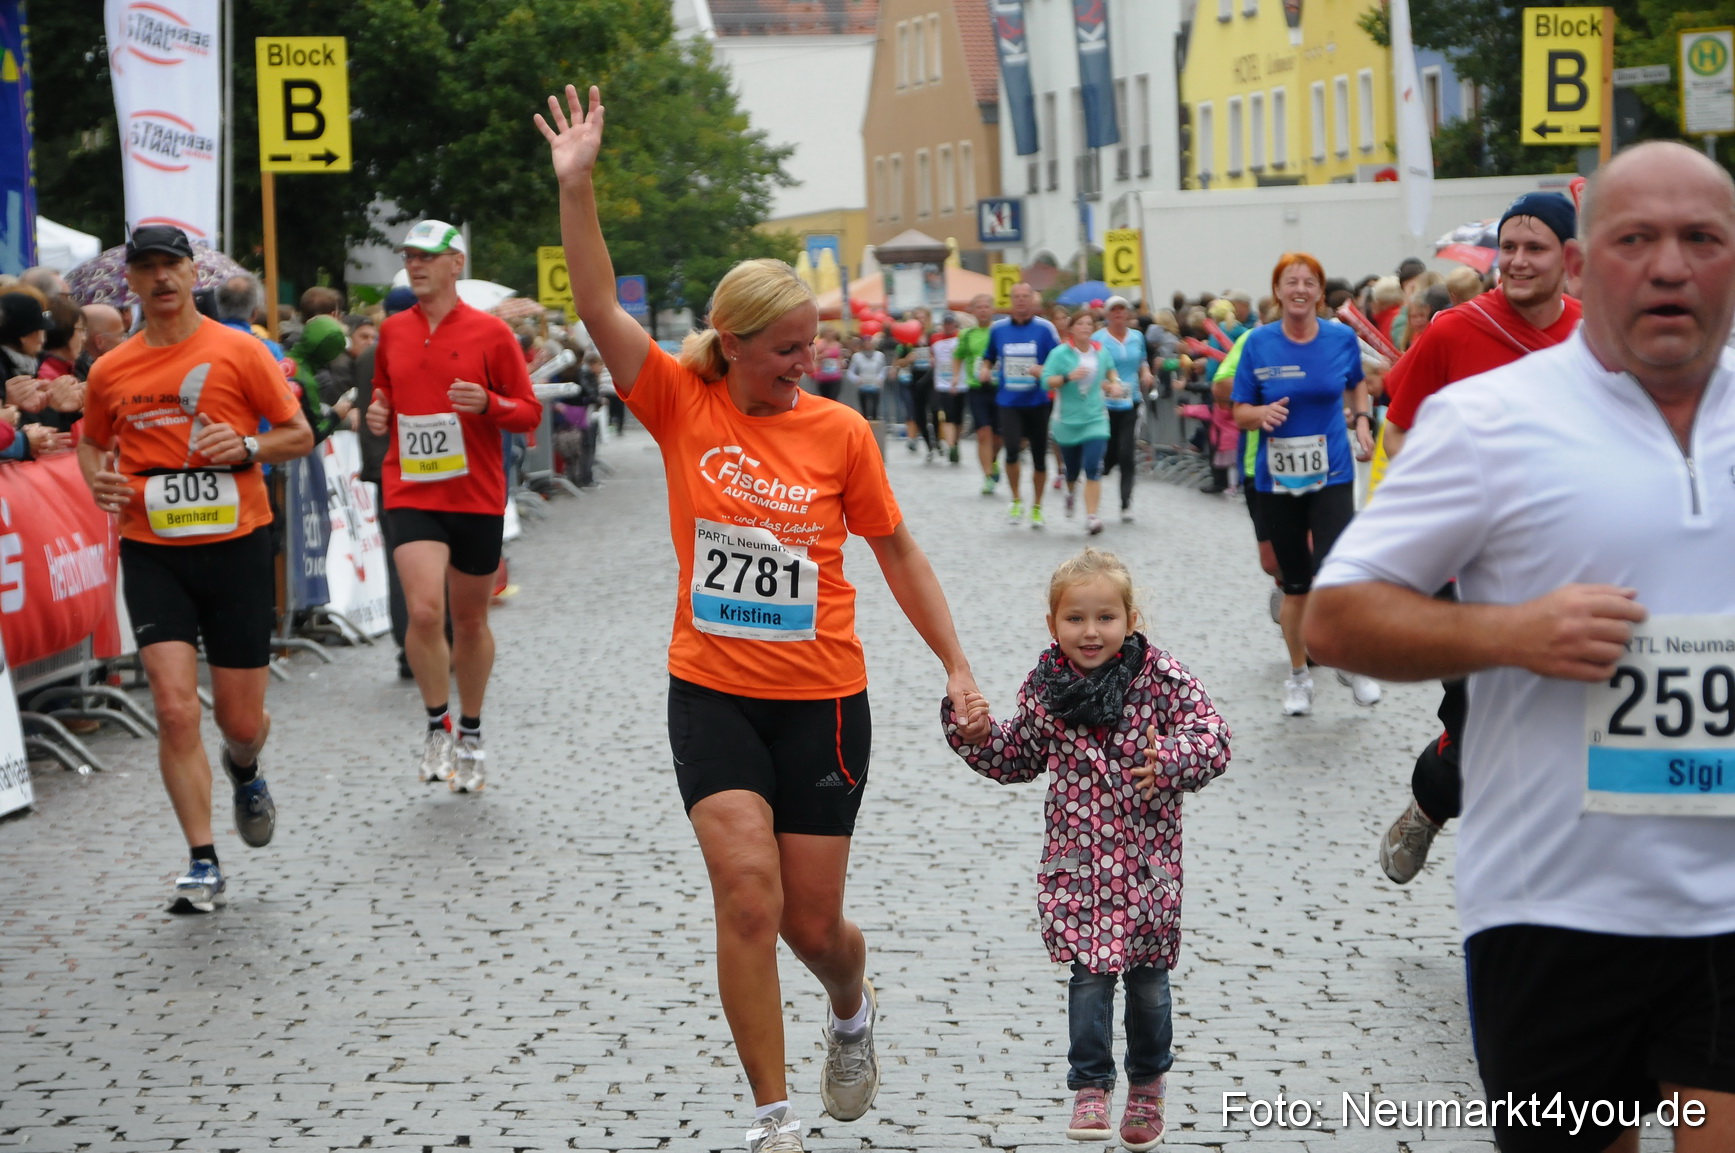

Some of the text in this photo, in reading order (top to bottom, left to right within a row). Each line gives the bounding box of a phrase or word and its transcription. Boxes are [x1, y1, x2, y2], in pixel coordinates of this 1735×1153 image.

[1535, 13, 1602, 37] Block
[267, 43, 336, 67] Block
[1547, 49, 1590, 112] B
[281, 78, 327, 142] B
[1113, 245, 1134, 274] C
[548, 264, 569, 292] C
[131, 394, 154, 404] Mai
[158, 393, 190, 406] 2008
[133, 415, 189, 431] Marathon
[406, 429, 449, 455] 202
[1274, 450, 1322, 473] 3118
[163, 472, 219, 505] 503
[717, 460, 818, 503] Fischer
[722, 485, 809, 515] AUTOMOBILE
[166, 510, 219, 525] Bernhard
[733, 515, 758, 527] und
[759, 517, 782, 532] das
[782, 521, 825, 534] Lächeln
[698, 528, 735, 547] PARTL
[703, 548, 801, 599] 2781
[719, 602, 782, 626] Kristina
[815, 780, 844, 788] adidas
[1668, 758, 1724, 792] Sigi
